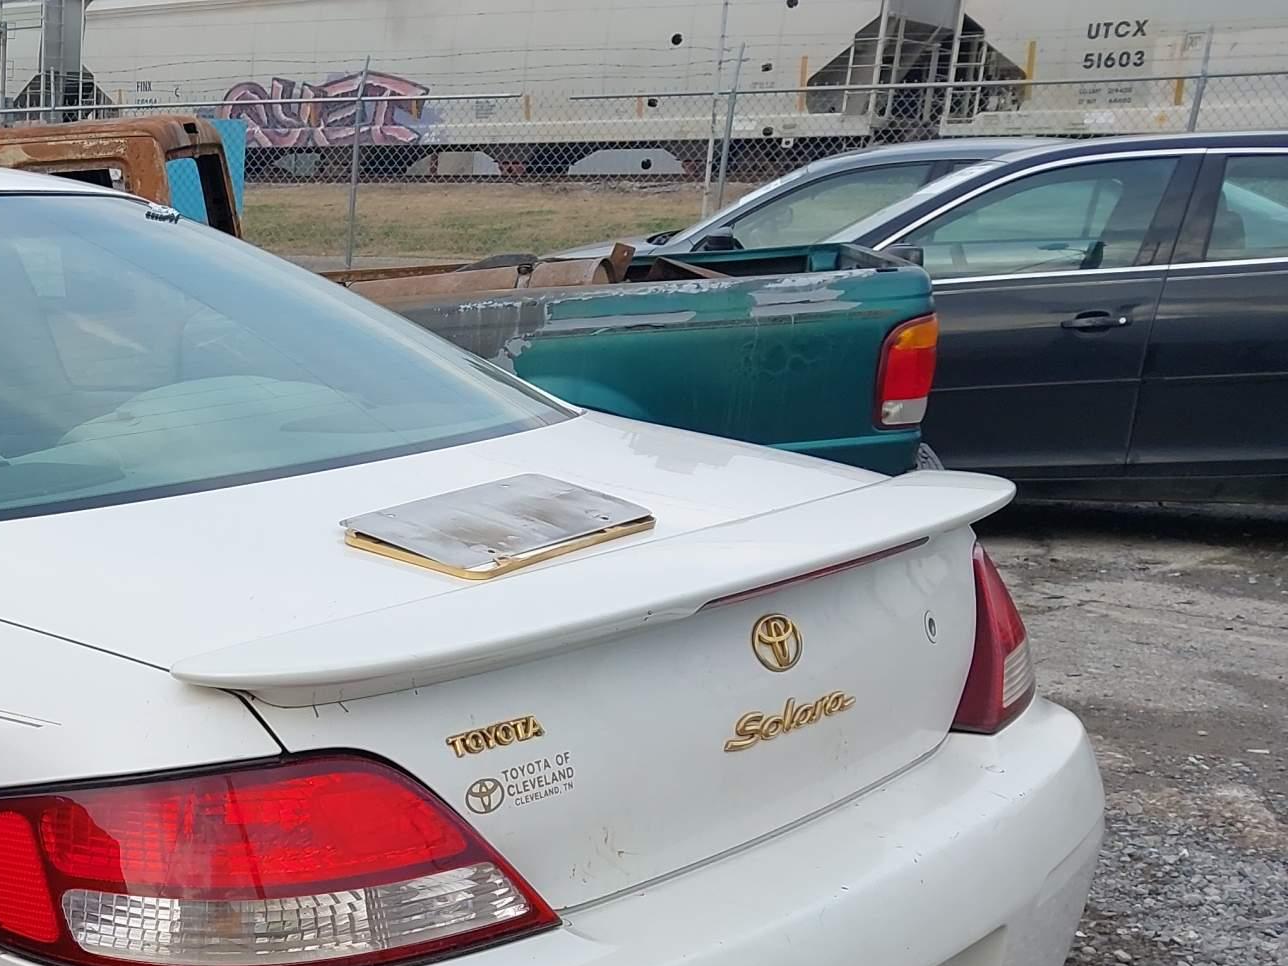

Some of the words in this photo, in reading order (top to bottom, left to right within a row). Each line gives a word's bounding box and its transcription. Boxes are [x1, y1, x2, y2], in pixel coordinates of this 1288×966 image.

[1087, 19, 1149, 39] UTCX
[1082, 50, 1145, 69] 51603
[445, 715, 545, 758] TOYOTA
[724, 691, 856, 752] Solara
[502, 758, 551, 782] TOYOTA
[555, 752, 570, 766] OF
[507, 767, 574, 797] CLEVELAND
[515, 786, 562, 806] CLEVELAND,
[564, 781, 574, 791] TN
